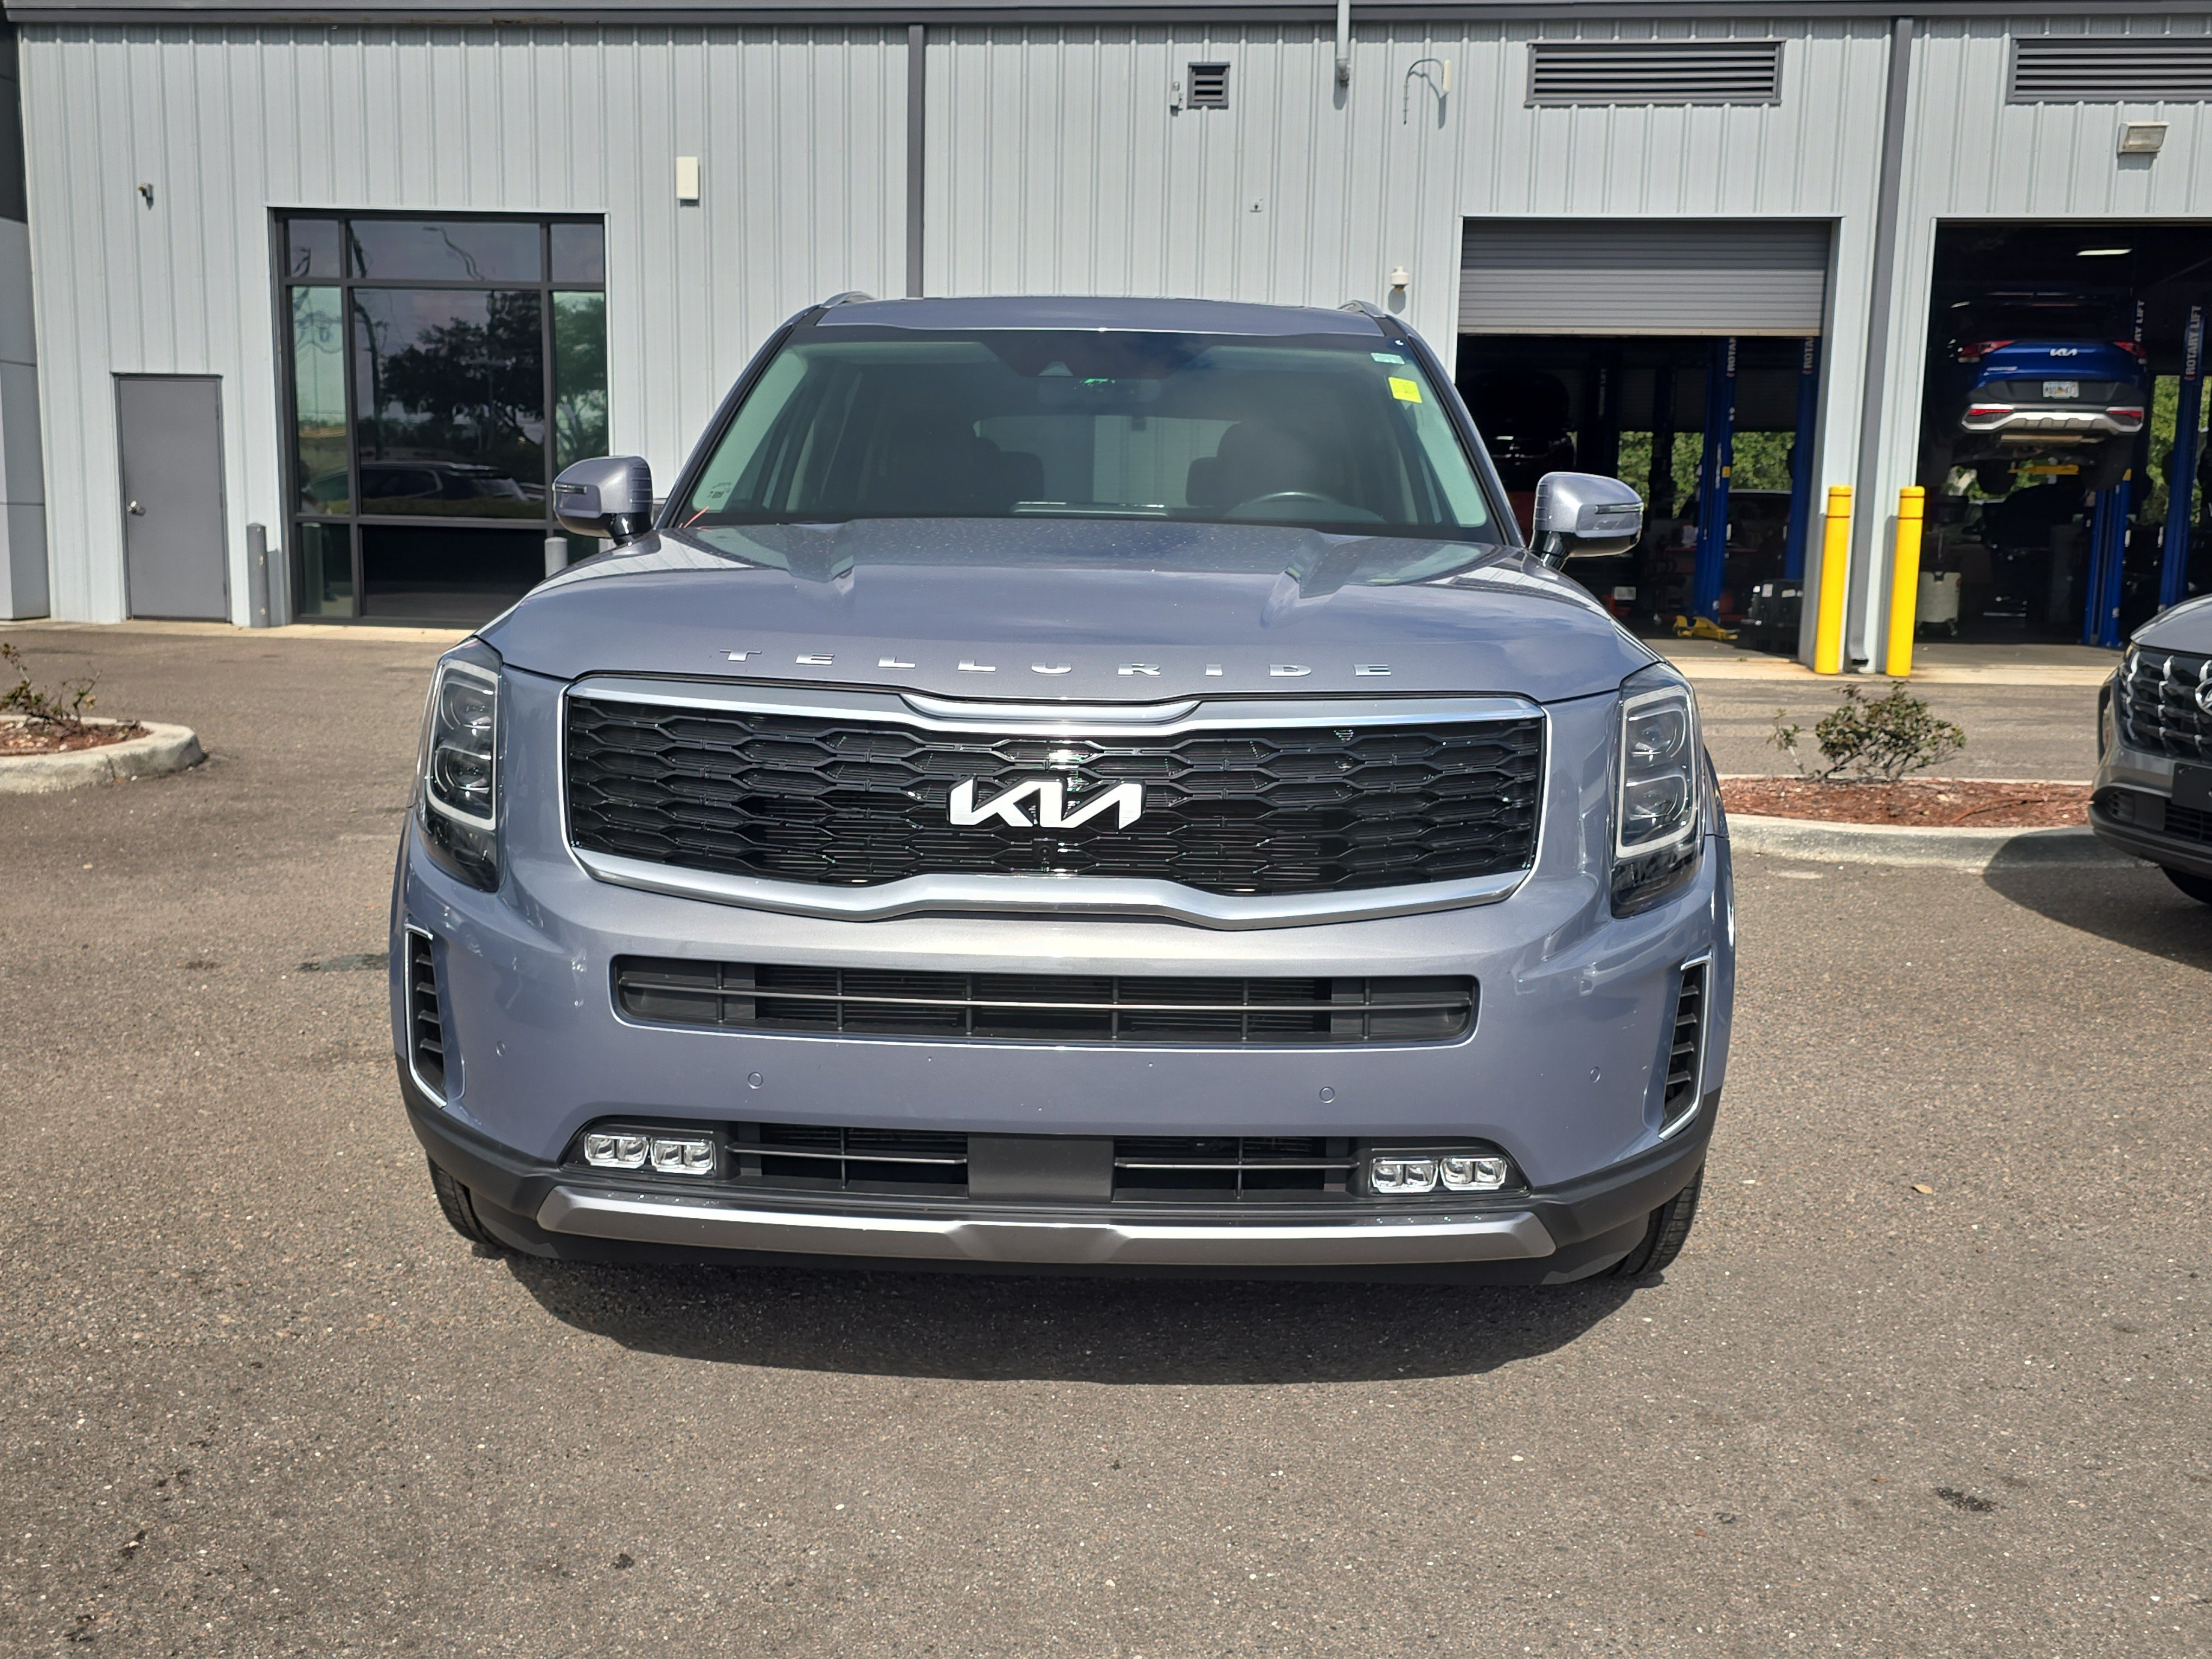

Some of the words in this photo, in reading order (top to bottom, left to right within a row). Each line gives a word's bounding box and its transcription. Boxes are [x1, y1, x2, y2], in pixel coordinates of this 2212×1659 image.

[2136, 299, 2145, 324] LIFT
[2190, 305, 2202, 329] LIFT
[2049, 348, 2078, 356] KIA
[2185, 331, 2200, 375] ROTARY
[719, 649, 1392, 677] TELLURIDE
[949, 778, 1142, 830] KIA
